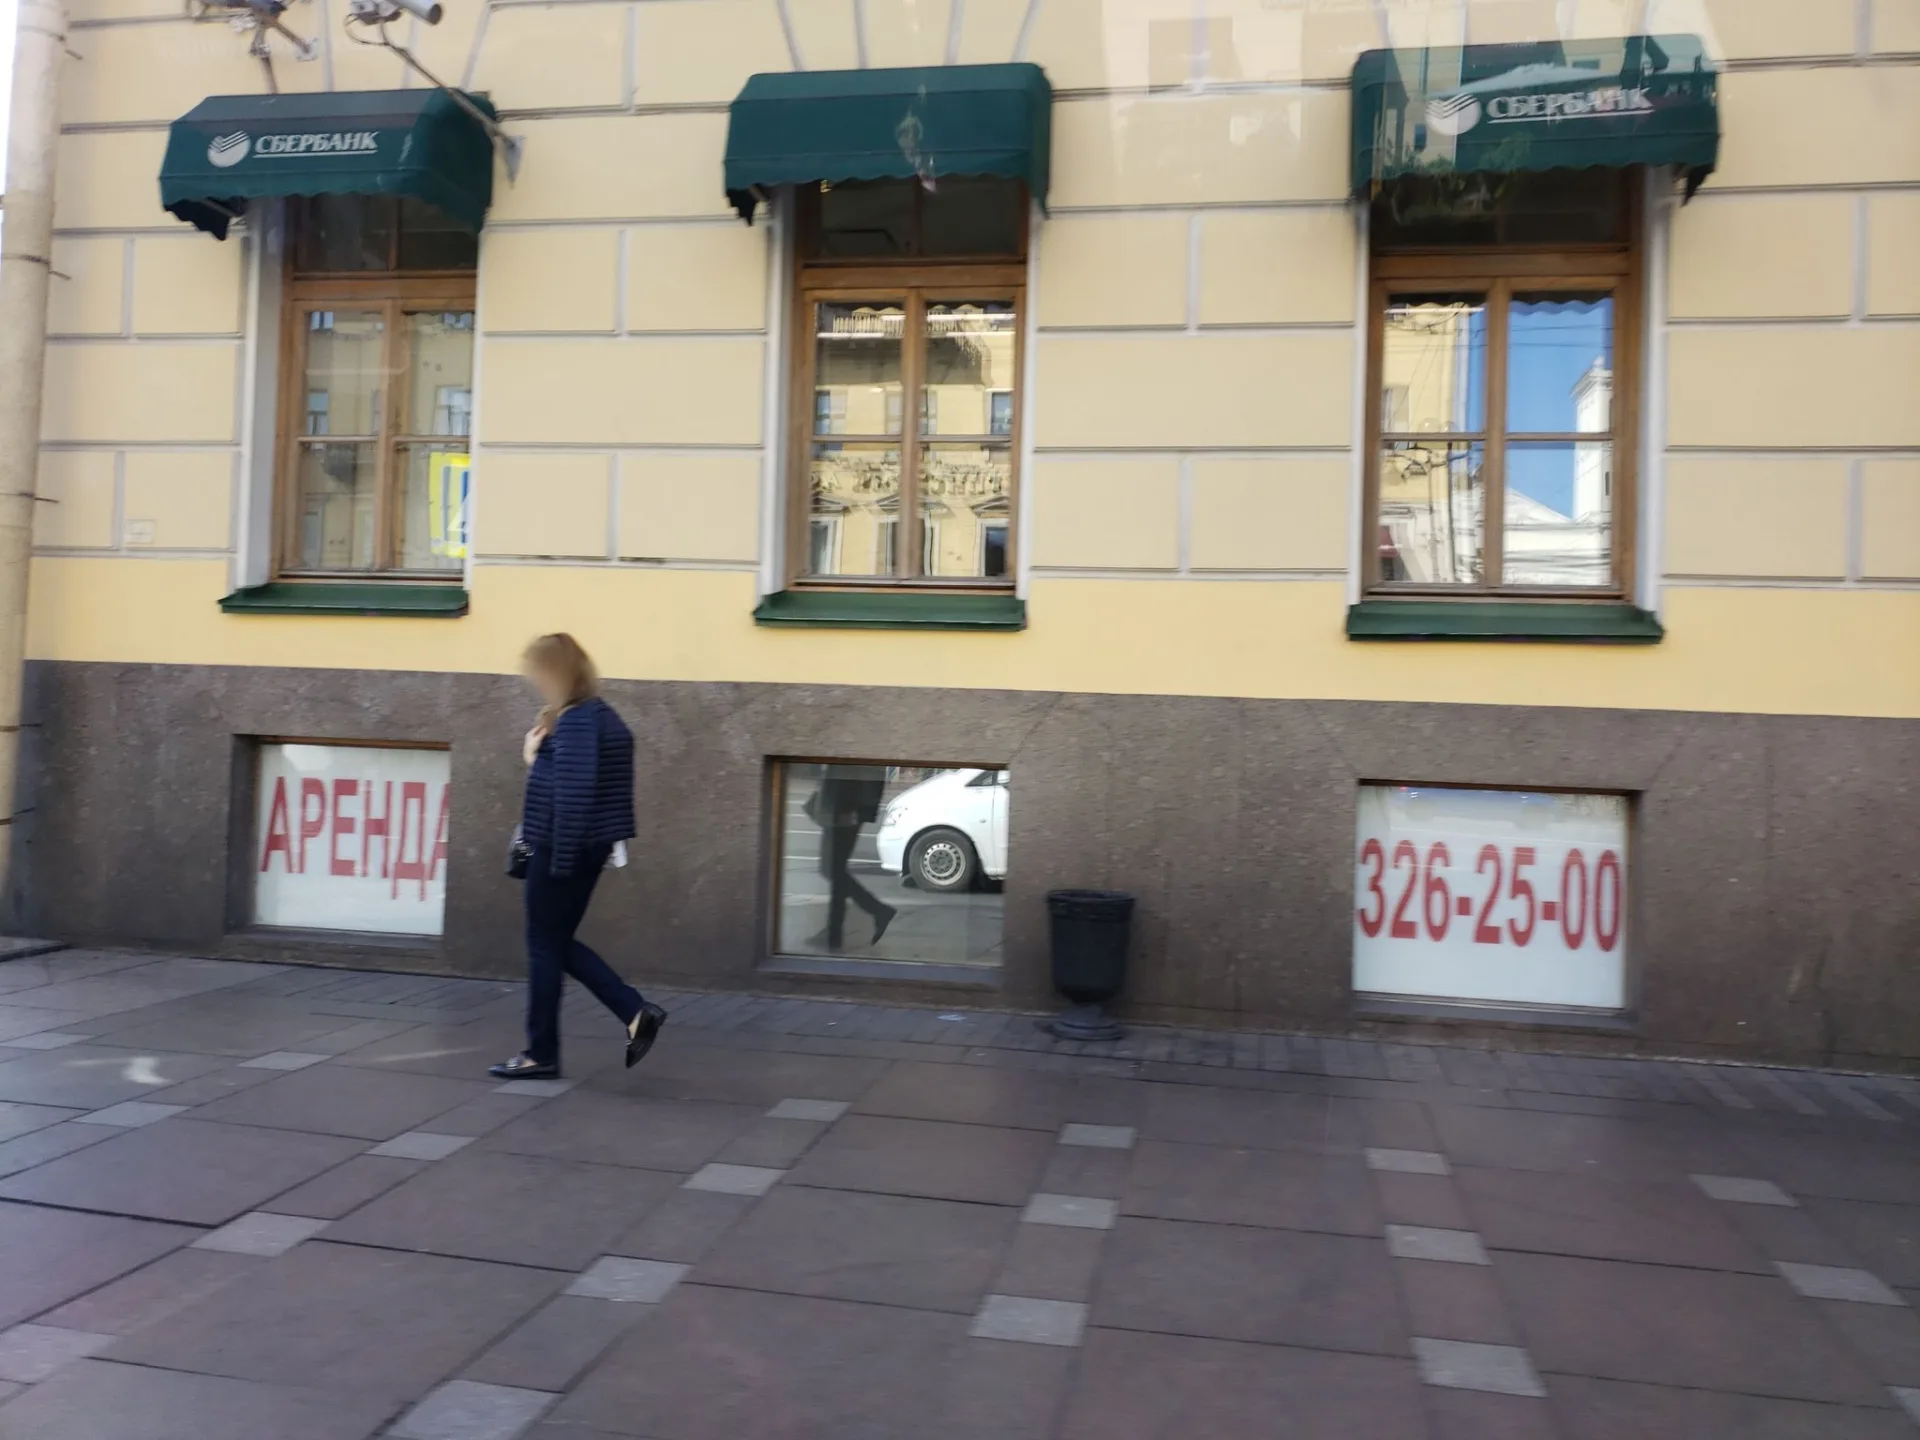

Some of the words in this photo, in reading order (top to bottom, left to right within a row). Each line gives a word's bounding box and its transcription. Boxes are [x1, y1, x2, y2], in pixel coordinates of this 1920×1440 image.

[1487, 87, 1654, 118] СБЕРБАНК
[255, 131, 379, 153] СБЕРБАНК
[1358, 838, 1621, 951] 326-25-00
